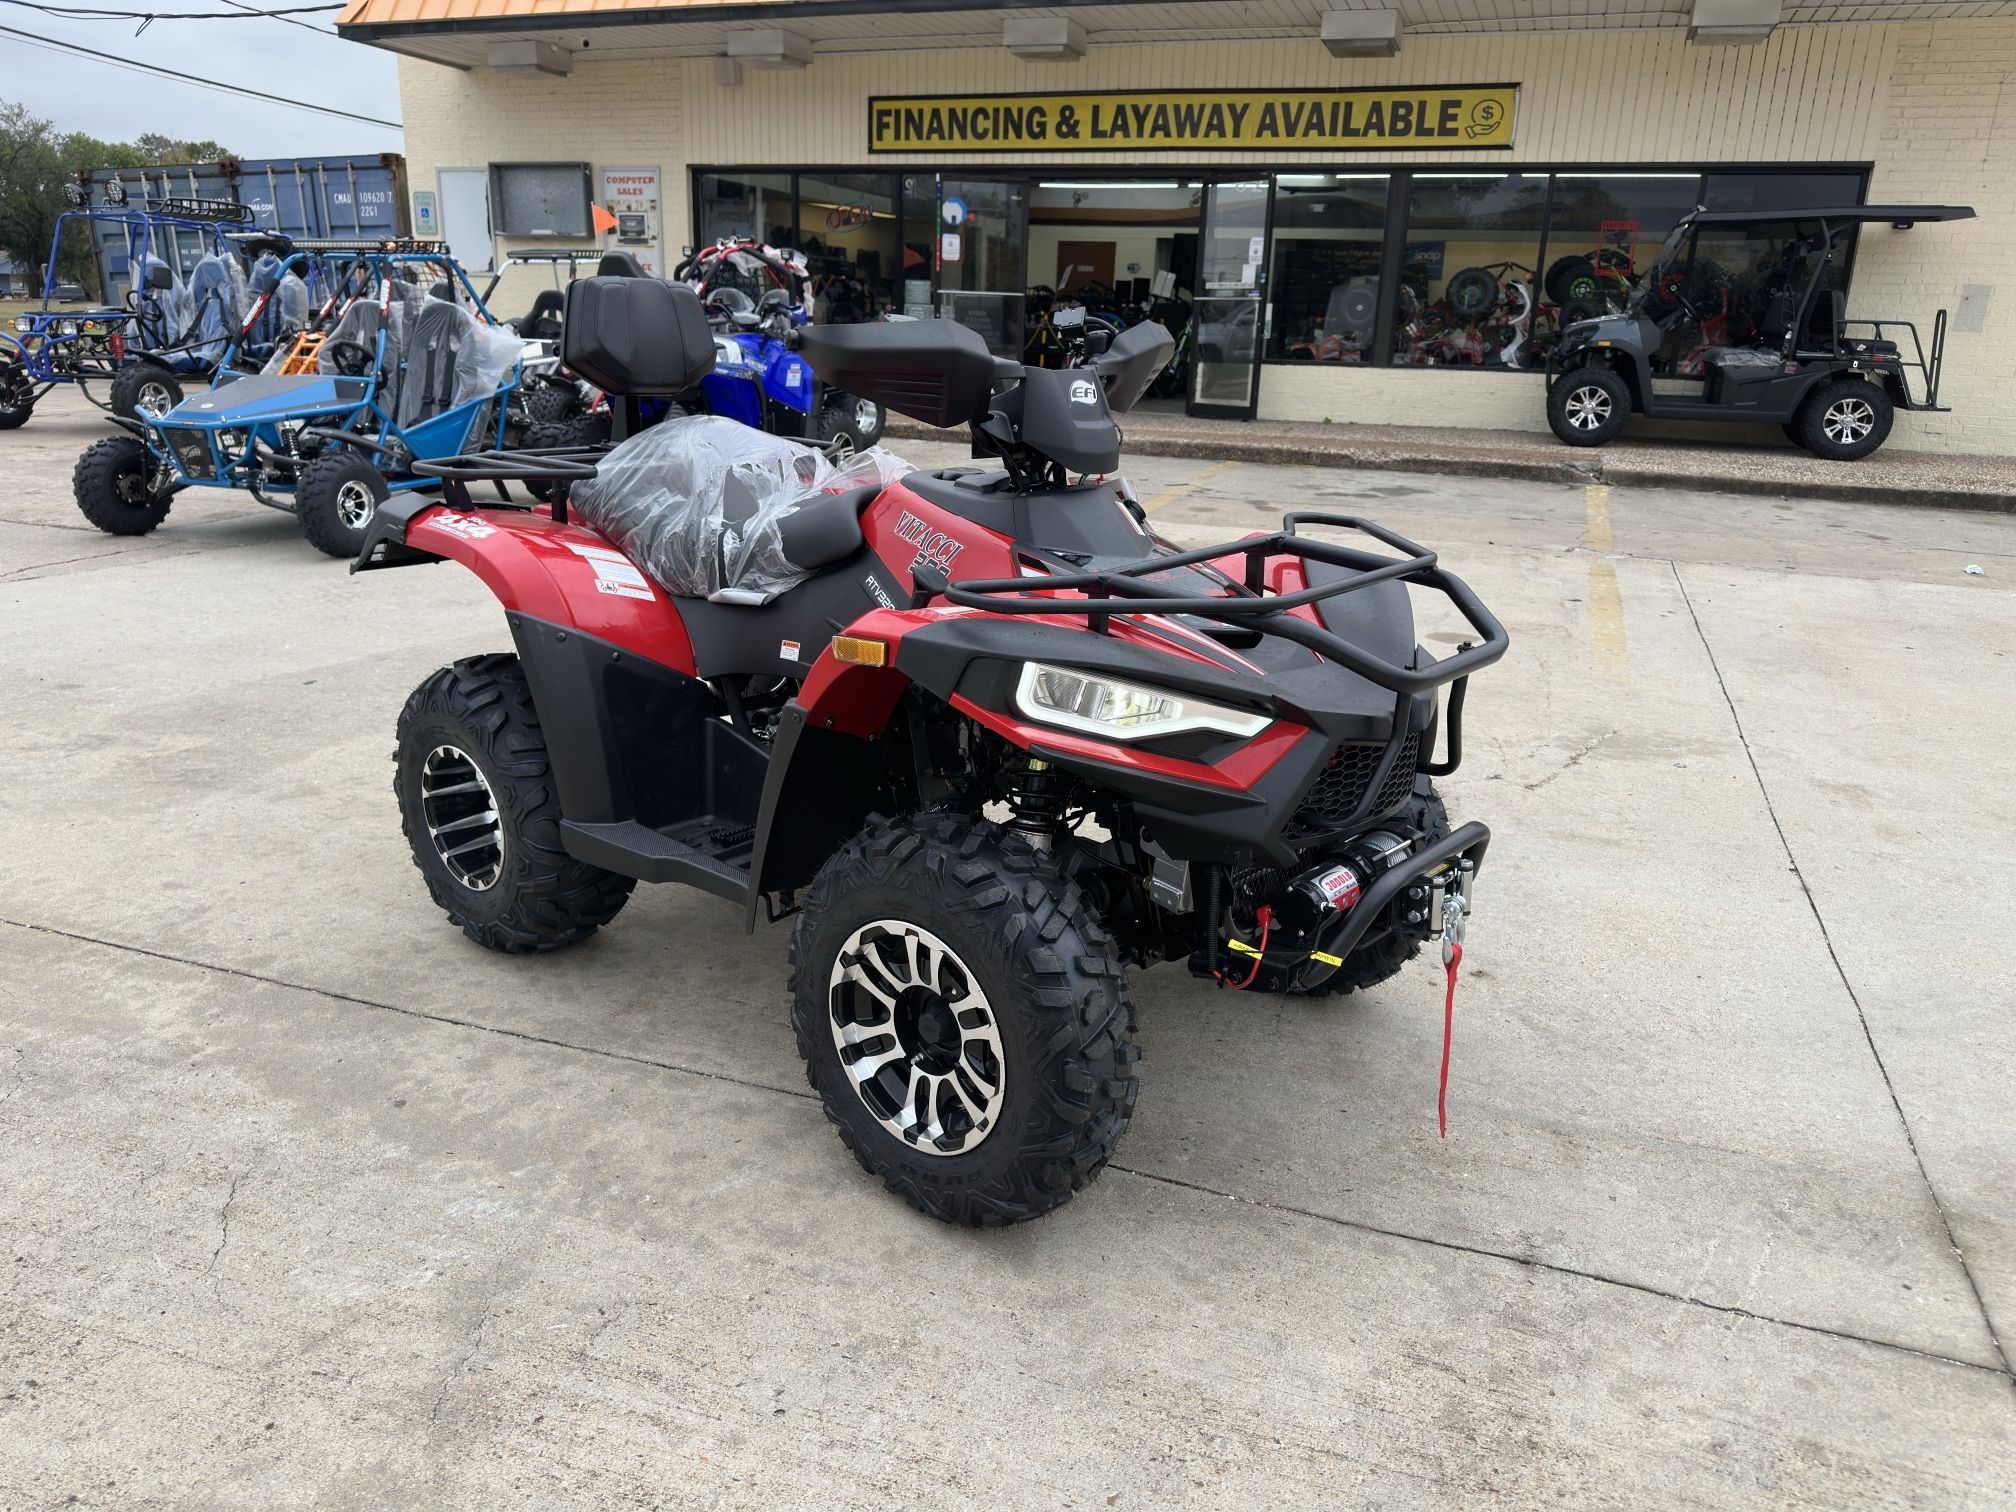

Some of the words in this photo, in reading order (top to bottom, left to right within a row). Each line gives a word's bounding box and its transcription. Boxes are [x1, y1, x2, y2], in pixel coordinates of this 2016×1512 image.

[876, 106, 1047, 141] FINANCING
[1055, 104, 1080, 139] &
[1091, 103, 1250, 139] LAYAWAY
[1255, 99, 1463, 139] AVAILABLE
[606, 176, 655, 184] COMPUTER
[334, 192, 351, 204] CMAU
[360, 191, 385, 203] 109620
[617, 187, 643, 195] SALES
[1072, 386, 1097, 399] EFI
[894, 510, 965, 565] VITACCI
